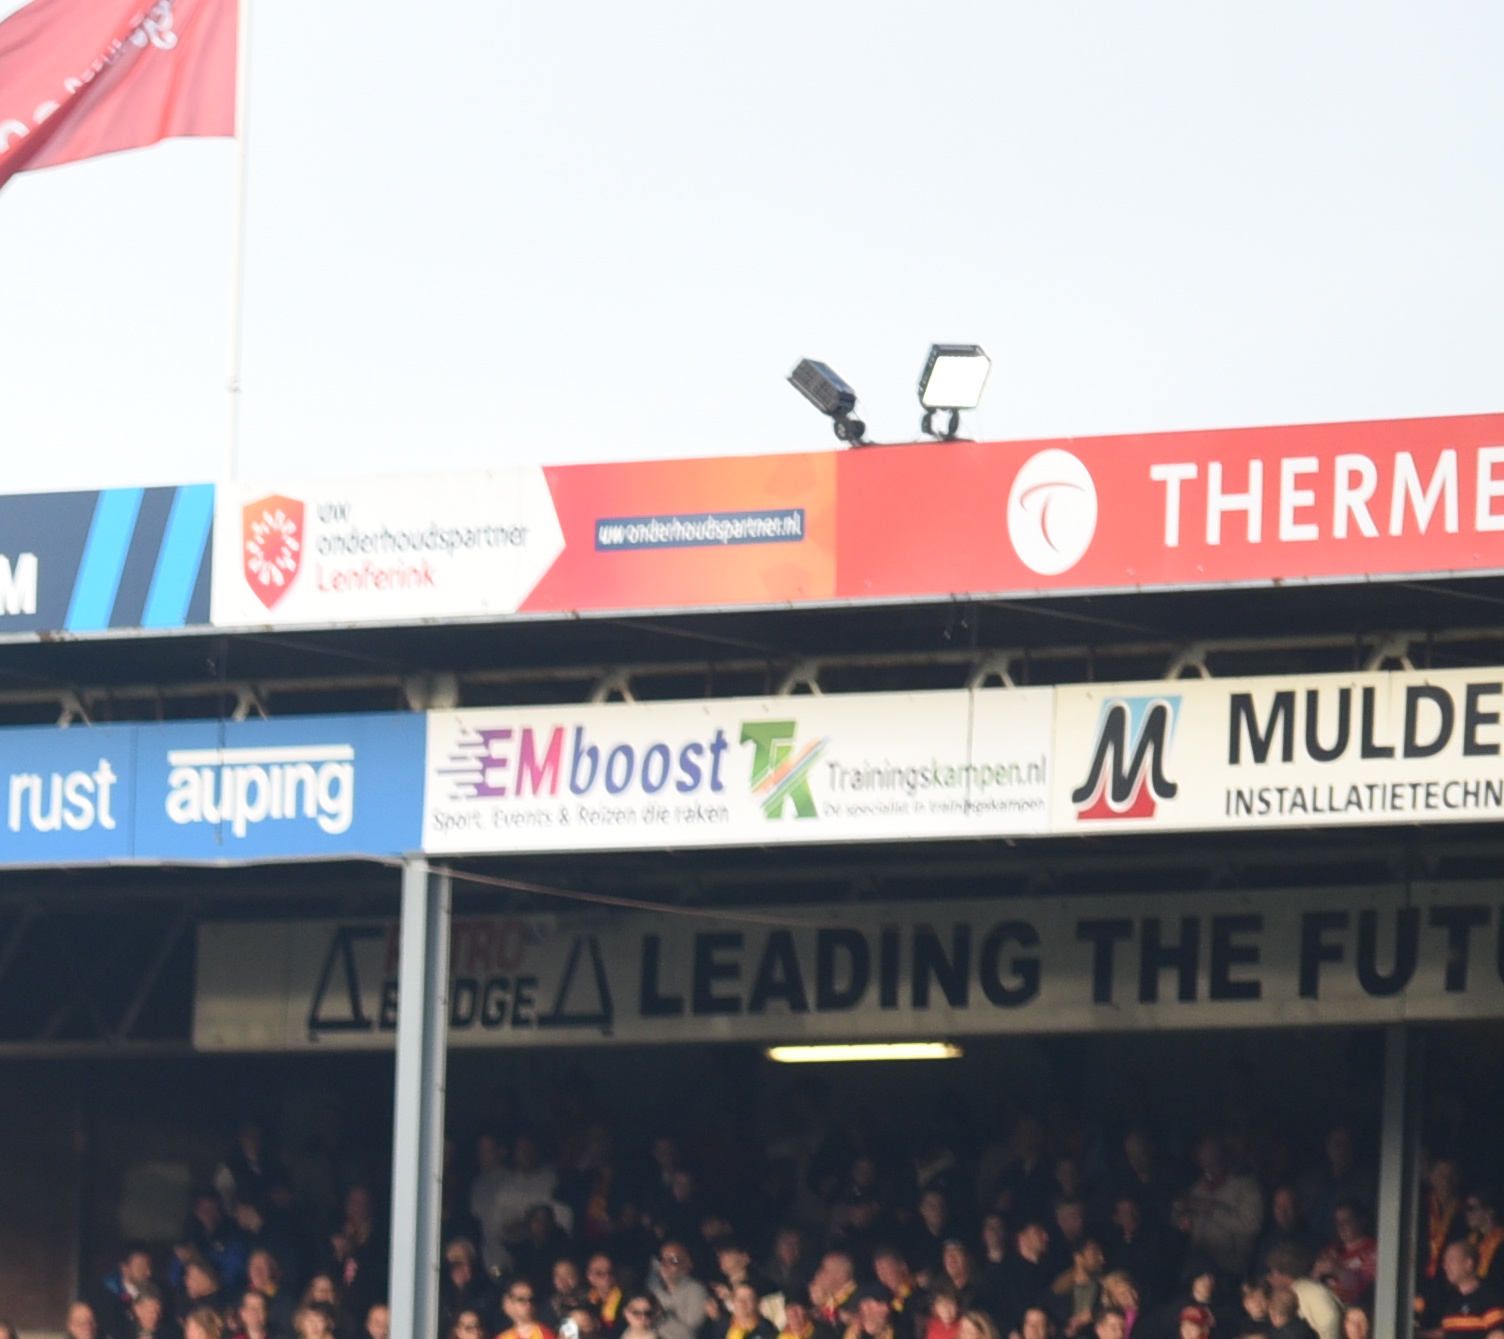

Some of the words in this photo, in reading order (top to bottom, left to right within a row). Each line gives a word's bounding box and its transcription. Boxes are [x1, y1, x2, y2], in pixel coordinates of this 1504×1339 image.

[315, 519, 529, 558] onderhoudspartner
[316, 558, 437, 592] Lenferink
[5, 755, 118, 833] rust
[165, 750, 355, 838] auping
[476, 725, 730, 799] EMboost
[826, 755, 1047, 794] Trainingskampen.nl
[637, 918, 1042, 1018] LEADING
[1075, 912, 1264, 1004] THE
[1298, 904, 1504, 999] FUT
